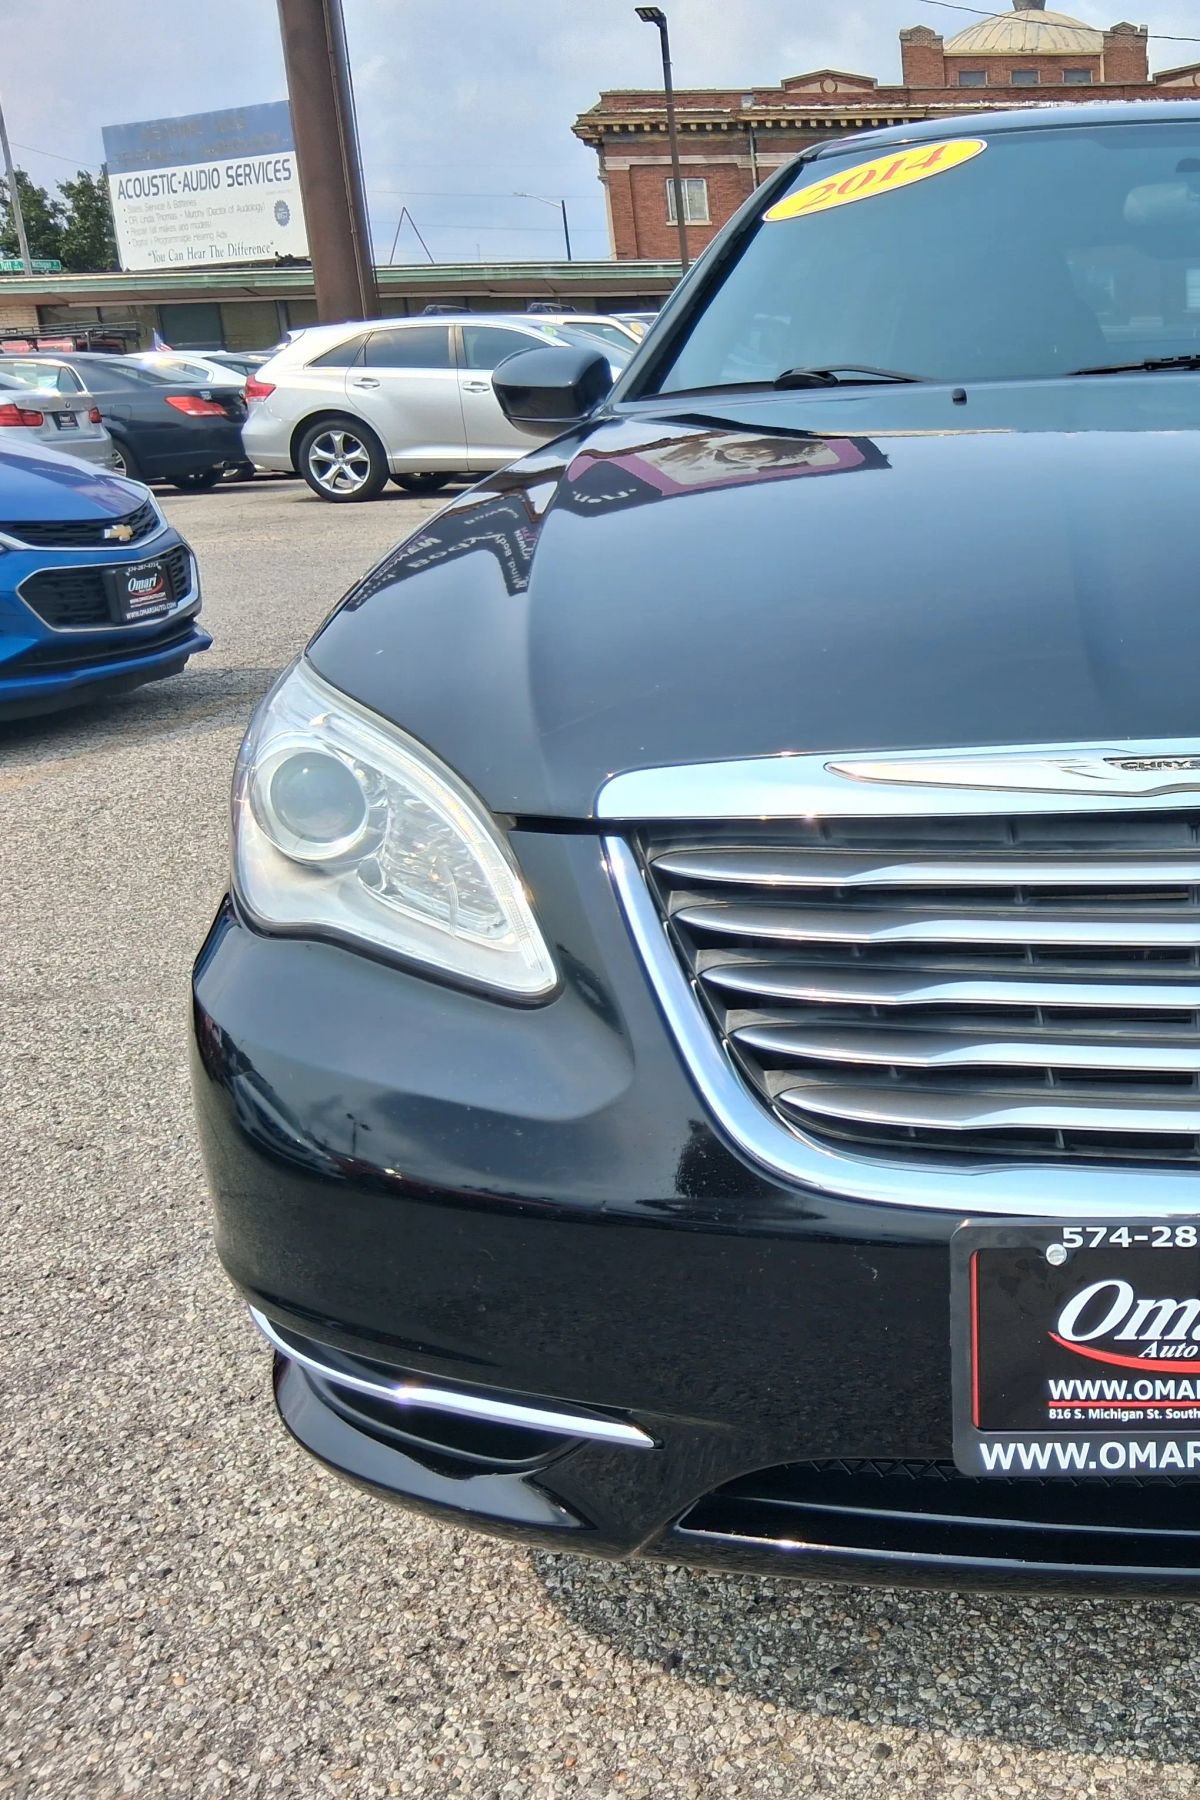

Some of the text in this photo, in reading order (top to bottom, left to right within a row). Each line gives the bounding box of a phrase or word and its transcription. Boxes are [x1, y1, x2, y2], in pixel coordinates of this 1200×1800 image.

[117, 158, 292, 200] ACOUSTIC-AUDIO SERVICES
[796, 145, 947, 211] 2014
[168, 248, 184, 261] Can
[187, 246, 206, 260] Hear
[209, 244, 224, 258] The
[128, 573, 157, 592] Omari
[1138, 1340, 1199, 1359] Auto
[1048, 1408, 1071, 1419] 816
[1074, 1408, 1085, 1419] S.
[1088, 1408, 1144, 1422] Michigan
[1146, 1408, 1162, 1419] St.
[1165, 1408, 1200, 1419] South
